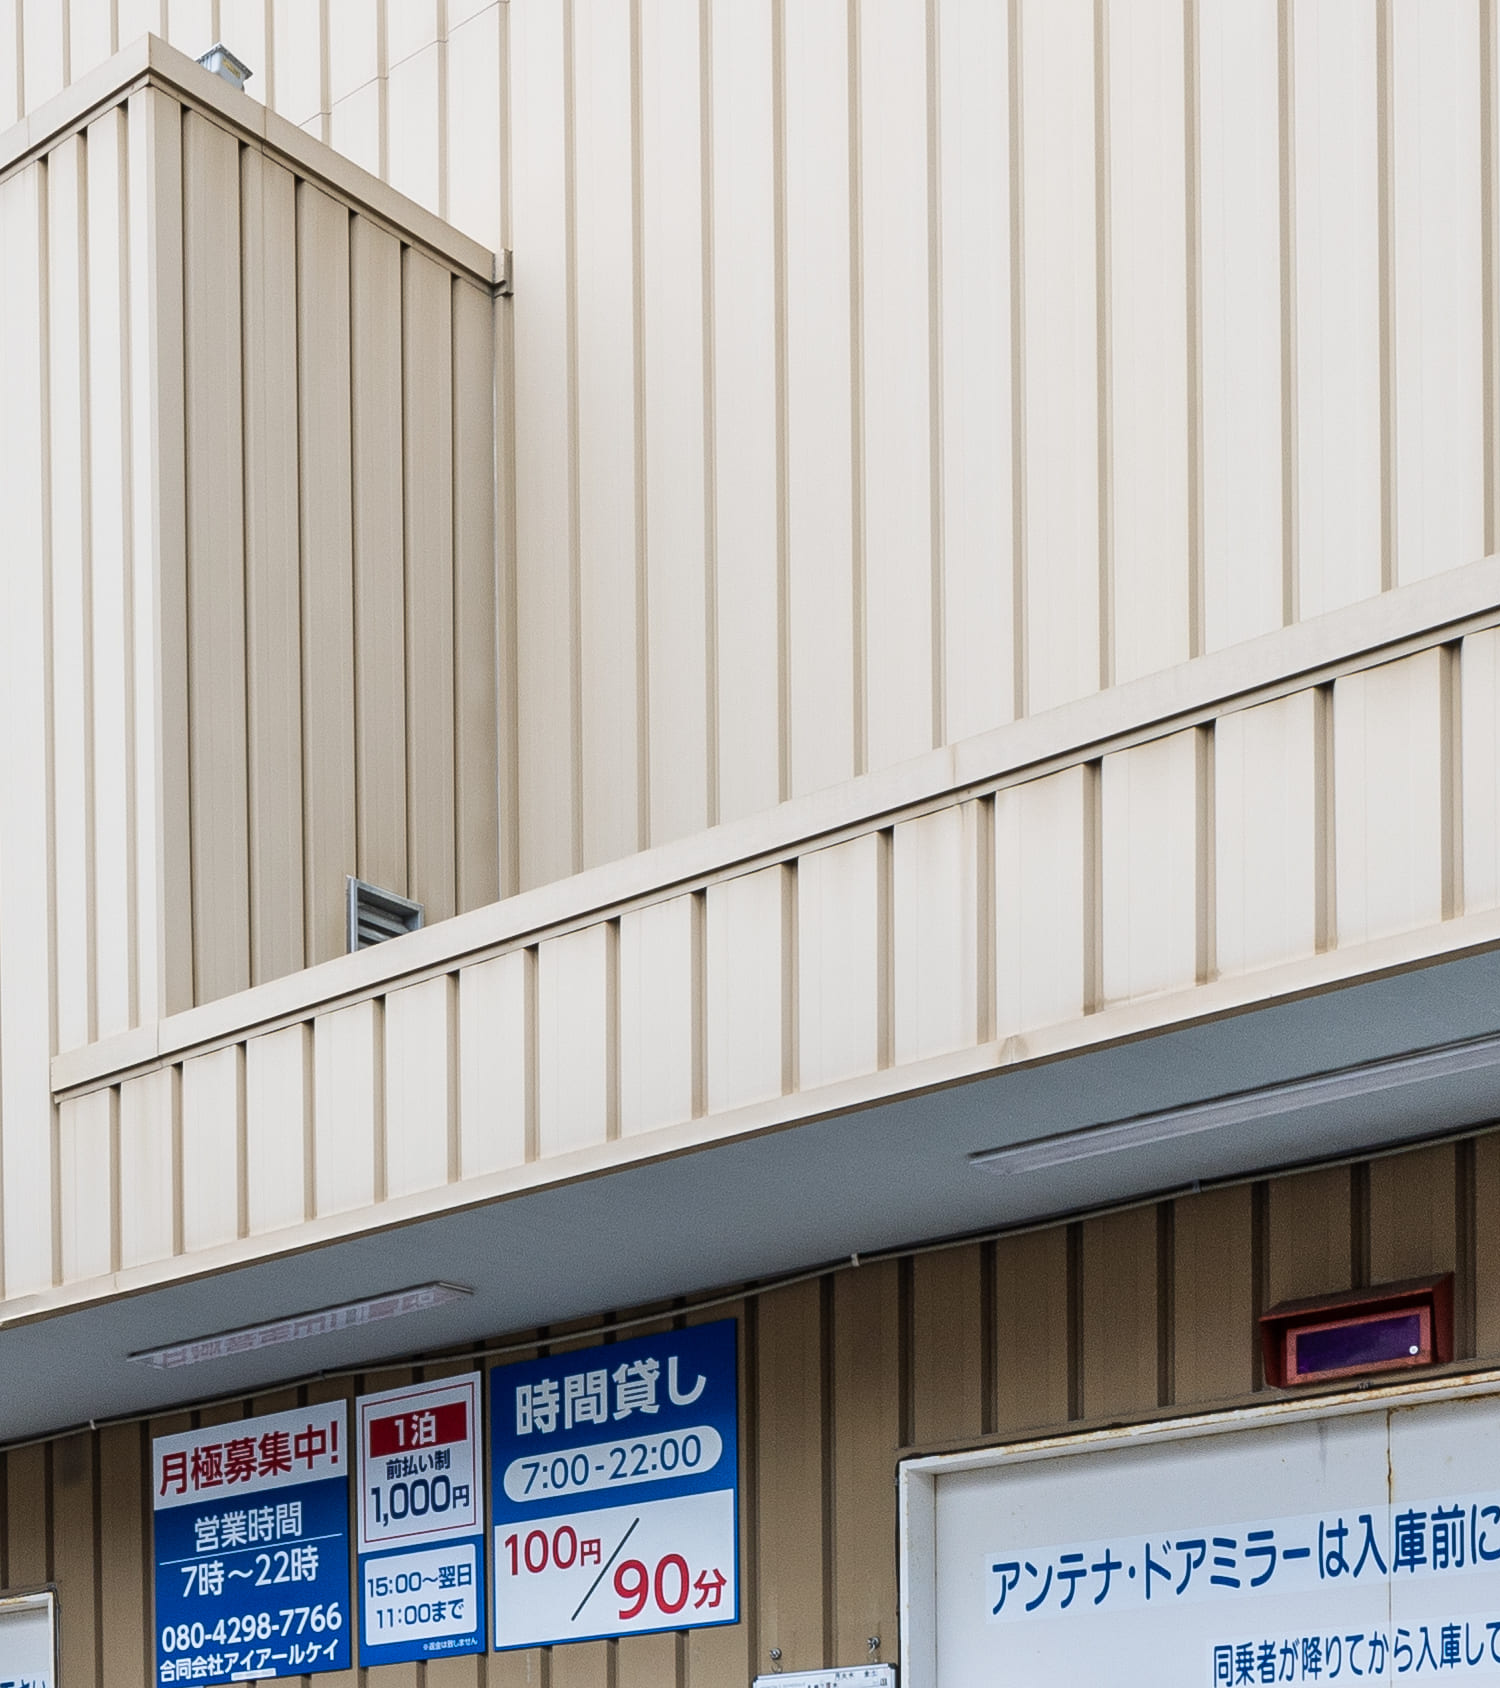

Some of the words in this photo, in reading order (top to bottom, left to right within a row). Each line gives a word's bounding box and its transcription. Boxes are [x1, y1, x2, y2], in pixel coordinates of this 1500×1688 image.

[516, 1356, 706, 1436] 時間貸し
[395, 1411, 436, 1447] 1泊
[159, 1420, 339, 1496] 月極募集中!
[386, 1450, 450, 1481] 前払い制
[194, 1502, 302, 1553] 営業時間
[371, 1476, 470, 1528] 1,000円
[161, 1602, 341, 1653] 080-4298-7766
[376, 1597, 464, 1629] 11:00まで
[159, 1638, 339, 1682] 合同会社アイアールケイ
